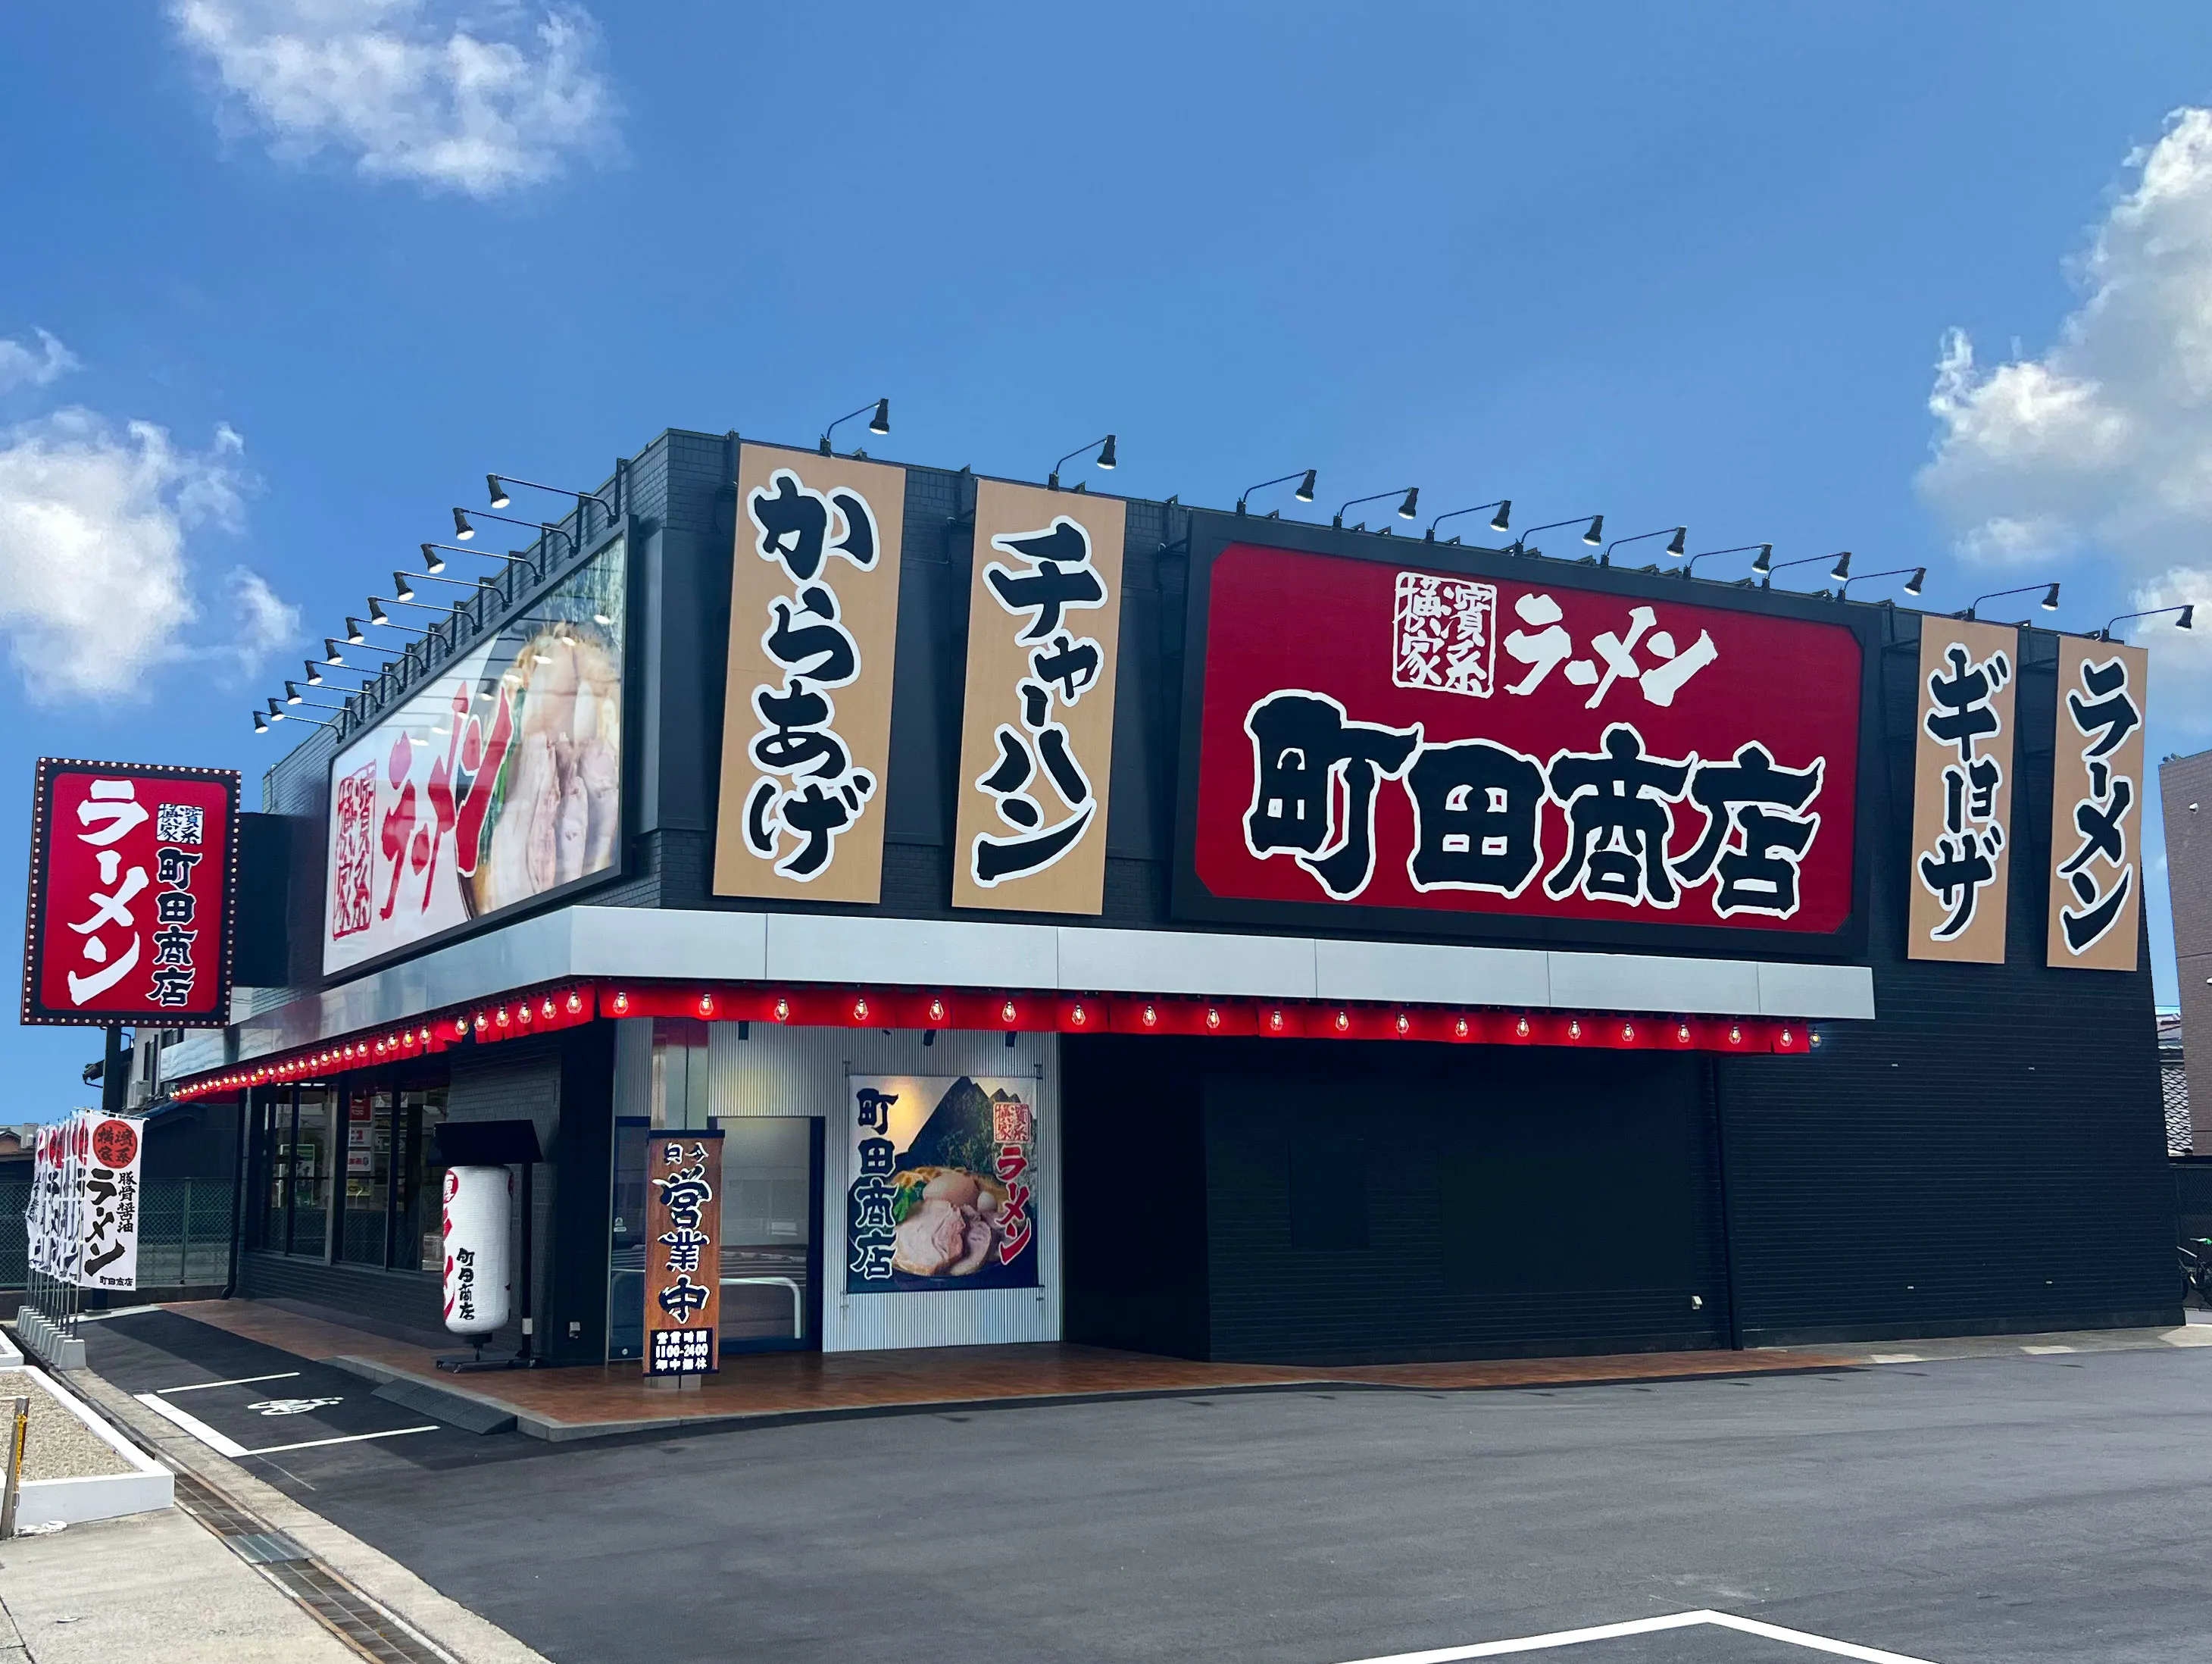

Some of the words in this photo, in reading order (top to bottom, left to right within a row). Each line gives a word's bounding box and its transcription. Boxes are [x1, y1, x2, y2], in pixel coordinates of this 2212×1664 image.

[742, 468, 879, 881] からあげ
[972, 515, 1108, 888] チャーハン
[1504, 593, 1718, 709] ラーメン
[67, 779, 149, 1006] ラーメン
[380, 680, 513, 920] ラーメン
[1243, 689, 1826, 919] 町田商店
[1917, 643, 2011, 941] ギョーザ
[2057, 656, 2142, 956] ラーメン
[146, 847, 202, 1007] 町田商店
[84, 1168, 126, 1277] ラーメン
[457, 1248, 475, 1321] 町田商店
[850, 1088, 899, 1280] 町田商店
[995, 1144, 1031, 1265] ラーメン
